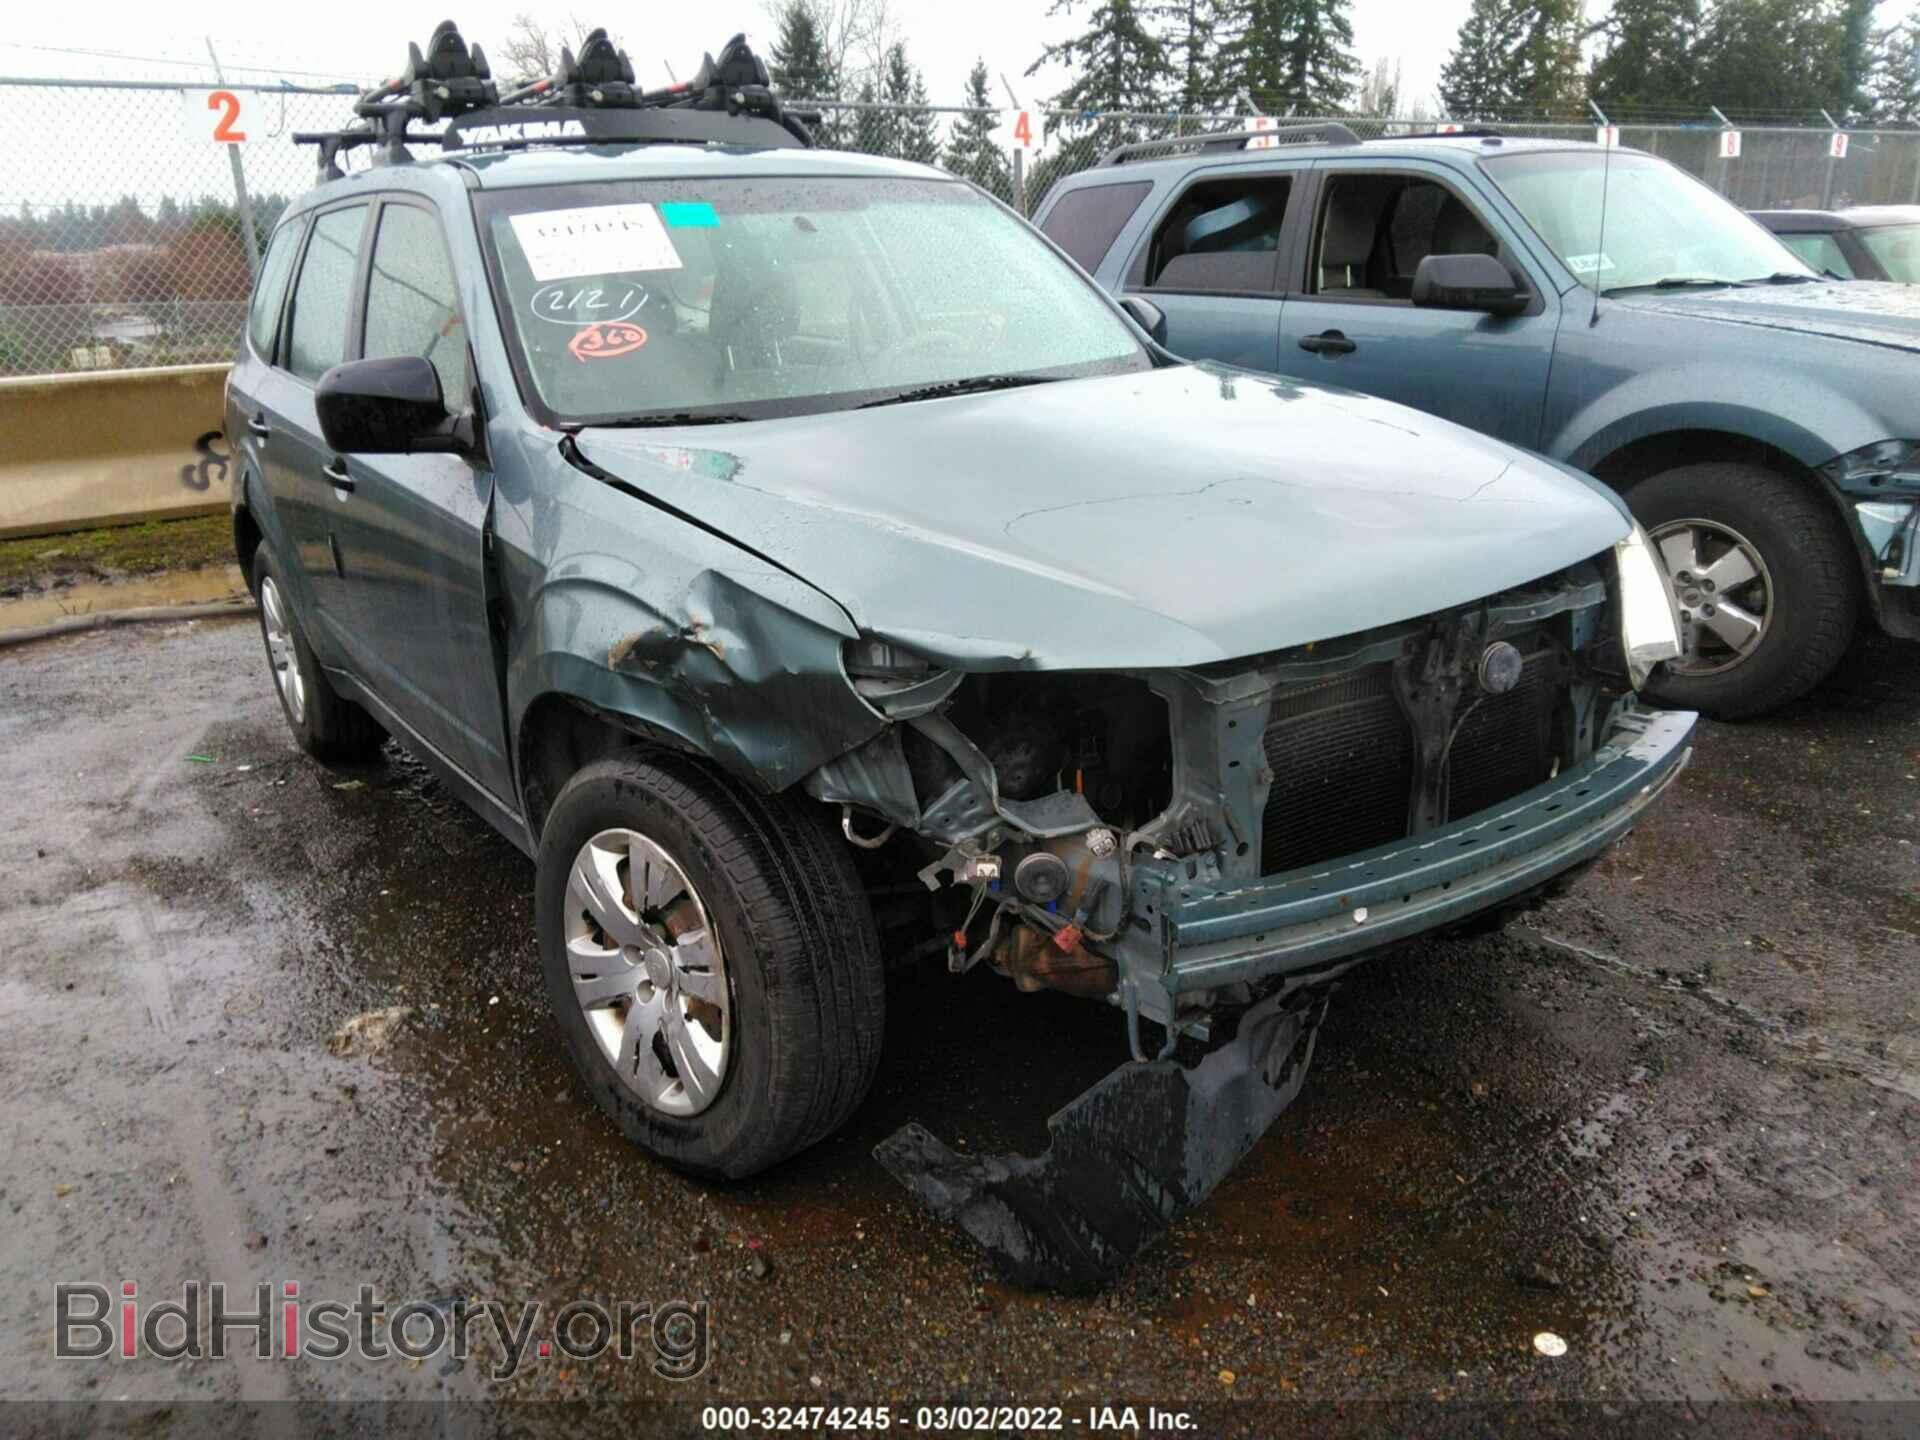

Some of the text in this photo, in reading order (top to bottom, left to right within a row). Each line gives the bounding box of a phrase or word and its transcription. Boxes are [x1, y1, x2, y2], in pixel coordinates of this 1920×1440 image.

[208, 91, 246, 142] 2
[1014, 111, 1032, 147] 4
[456, 119, 587, 146] YAKIMA
[1727, 133, 1735, 155] 8
[1836, 134, 1844, 155] 9
